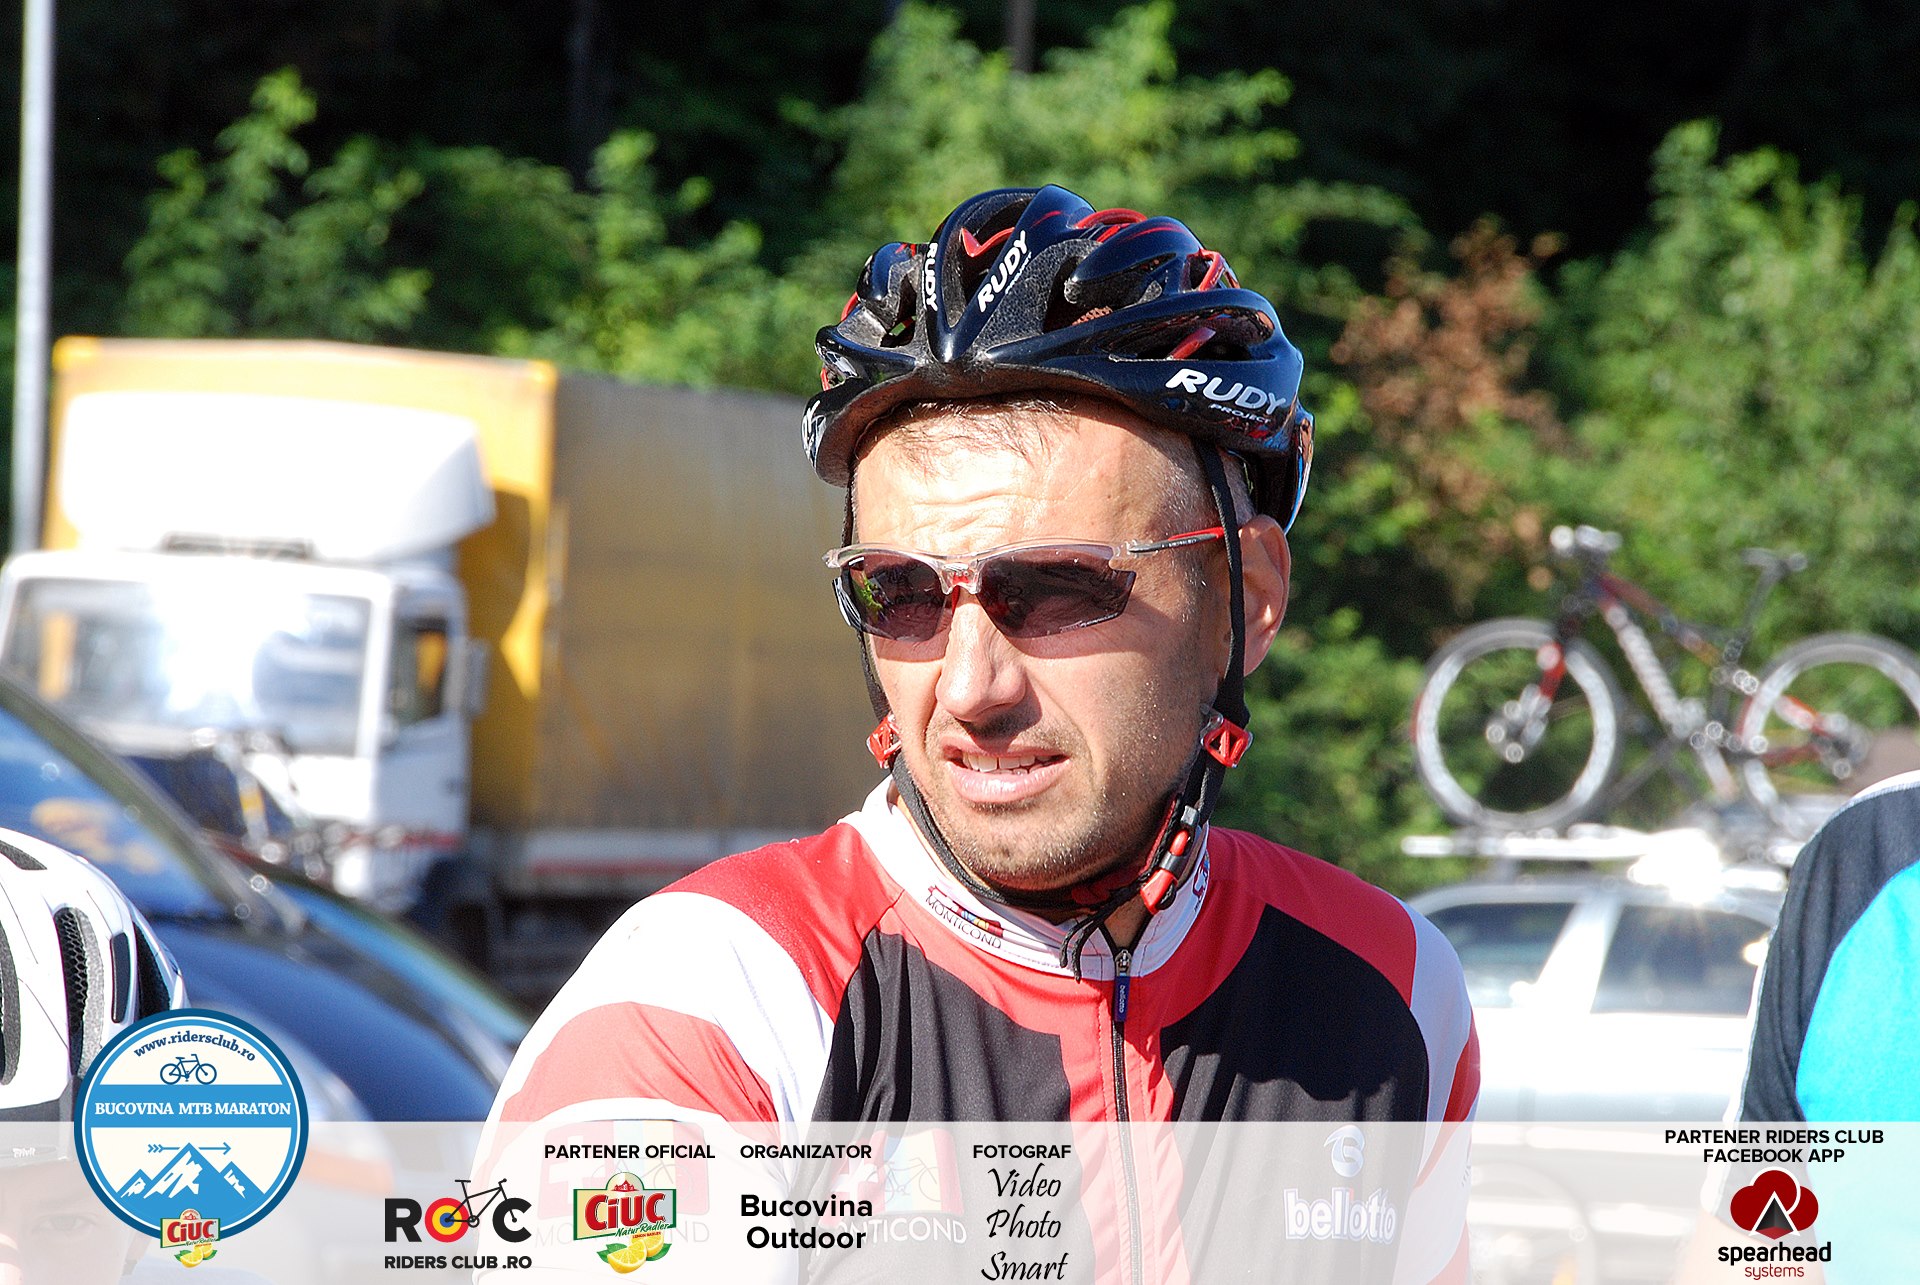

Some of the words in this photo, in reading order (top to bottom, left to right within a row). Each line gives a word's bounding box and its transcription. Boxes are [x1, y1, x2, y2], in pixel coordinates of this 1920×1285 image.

[924, 242, 938, 312] RUDY
[978, 230, 1027, 313] RUDY
[1165, 368, 1286, 415] RUDY
[1208, 403, 1272, 424] PROJECT
[925, 894, 1002, 949] MONTICOND
